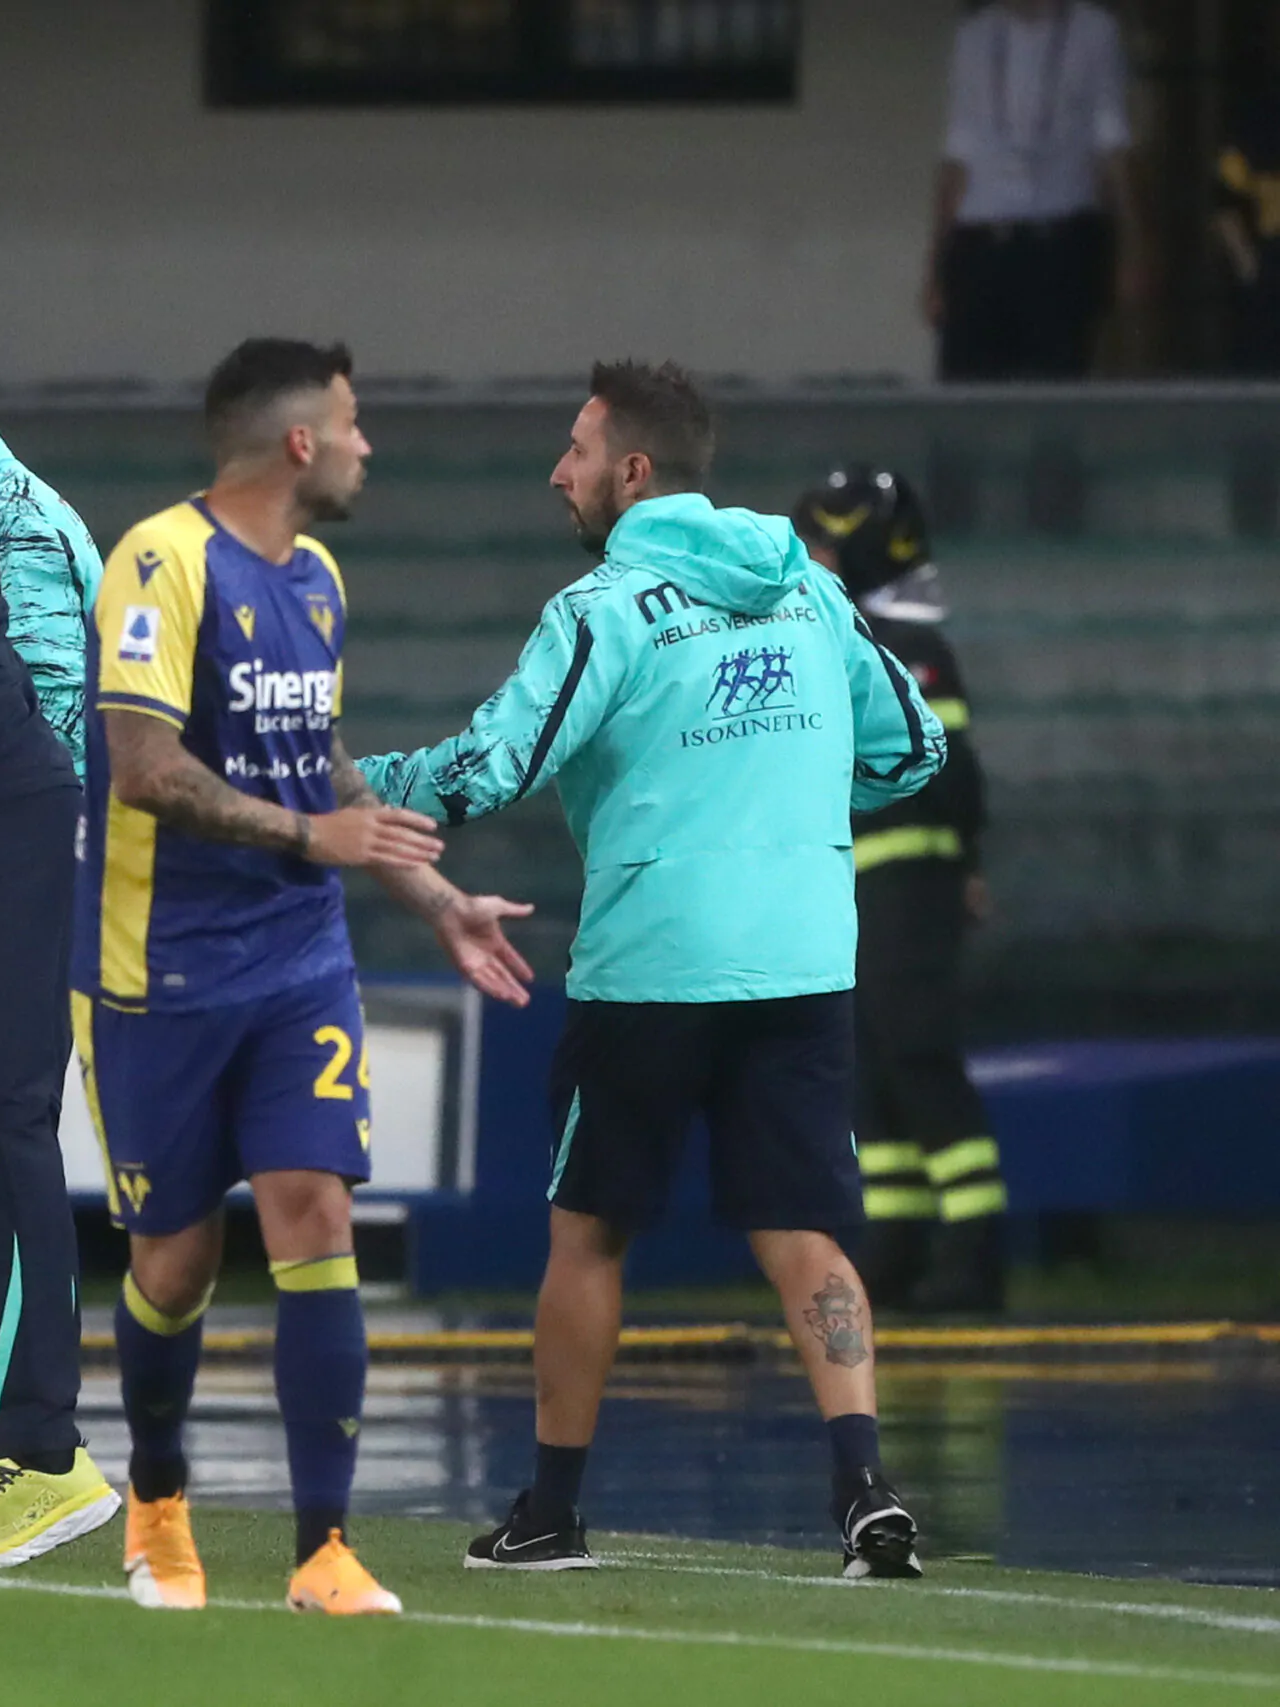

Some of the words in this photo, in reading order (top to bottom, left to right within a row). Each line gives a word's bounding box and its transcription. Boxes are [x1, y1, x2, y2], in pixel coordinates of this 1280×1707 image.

[653, 617, 721, 650] HELLAS
[796, 606, 817, 623] FC
[228, 657, 335, 714] Sinerg
[680, 712, 824, 748] ISOKINETIC
